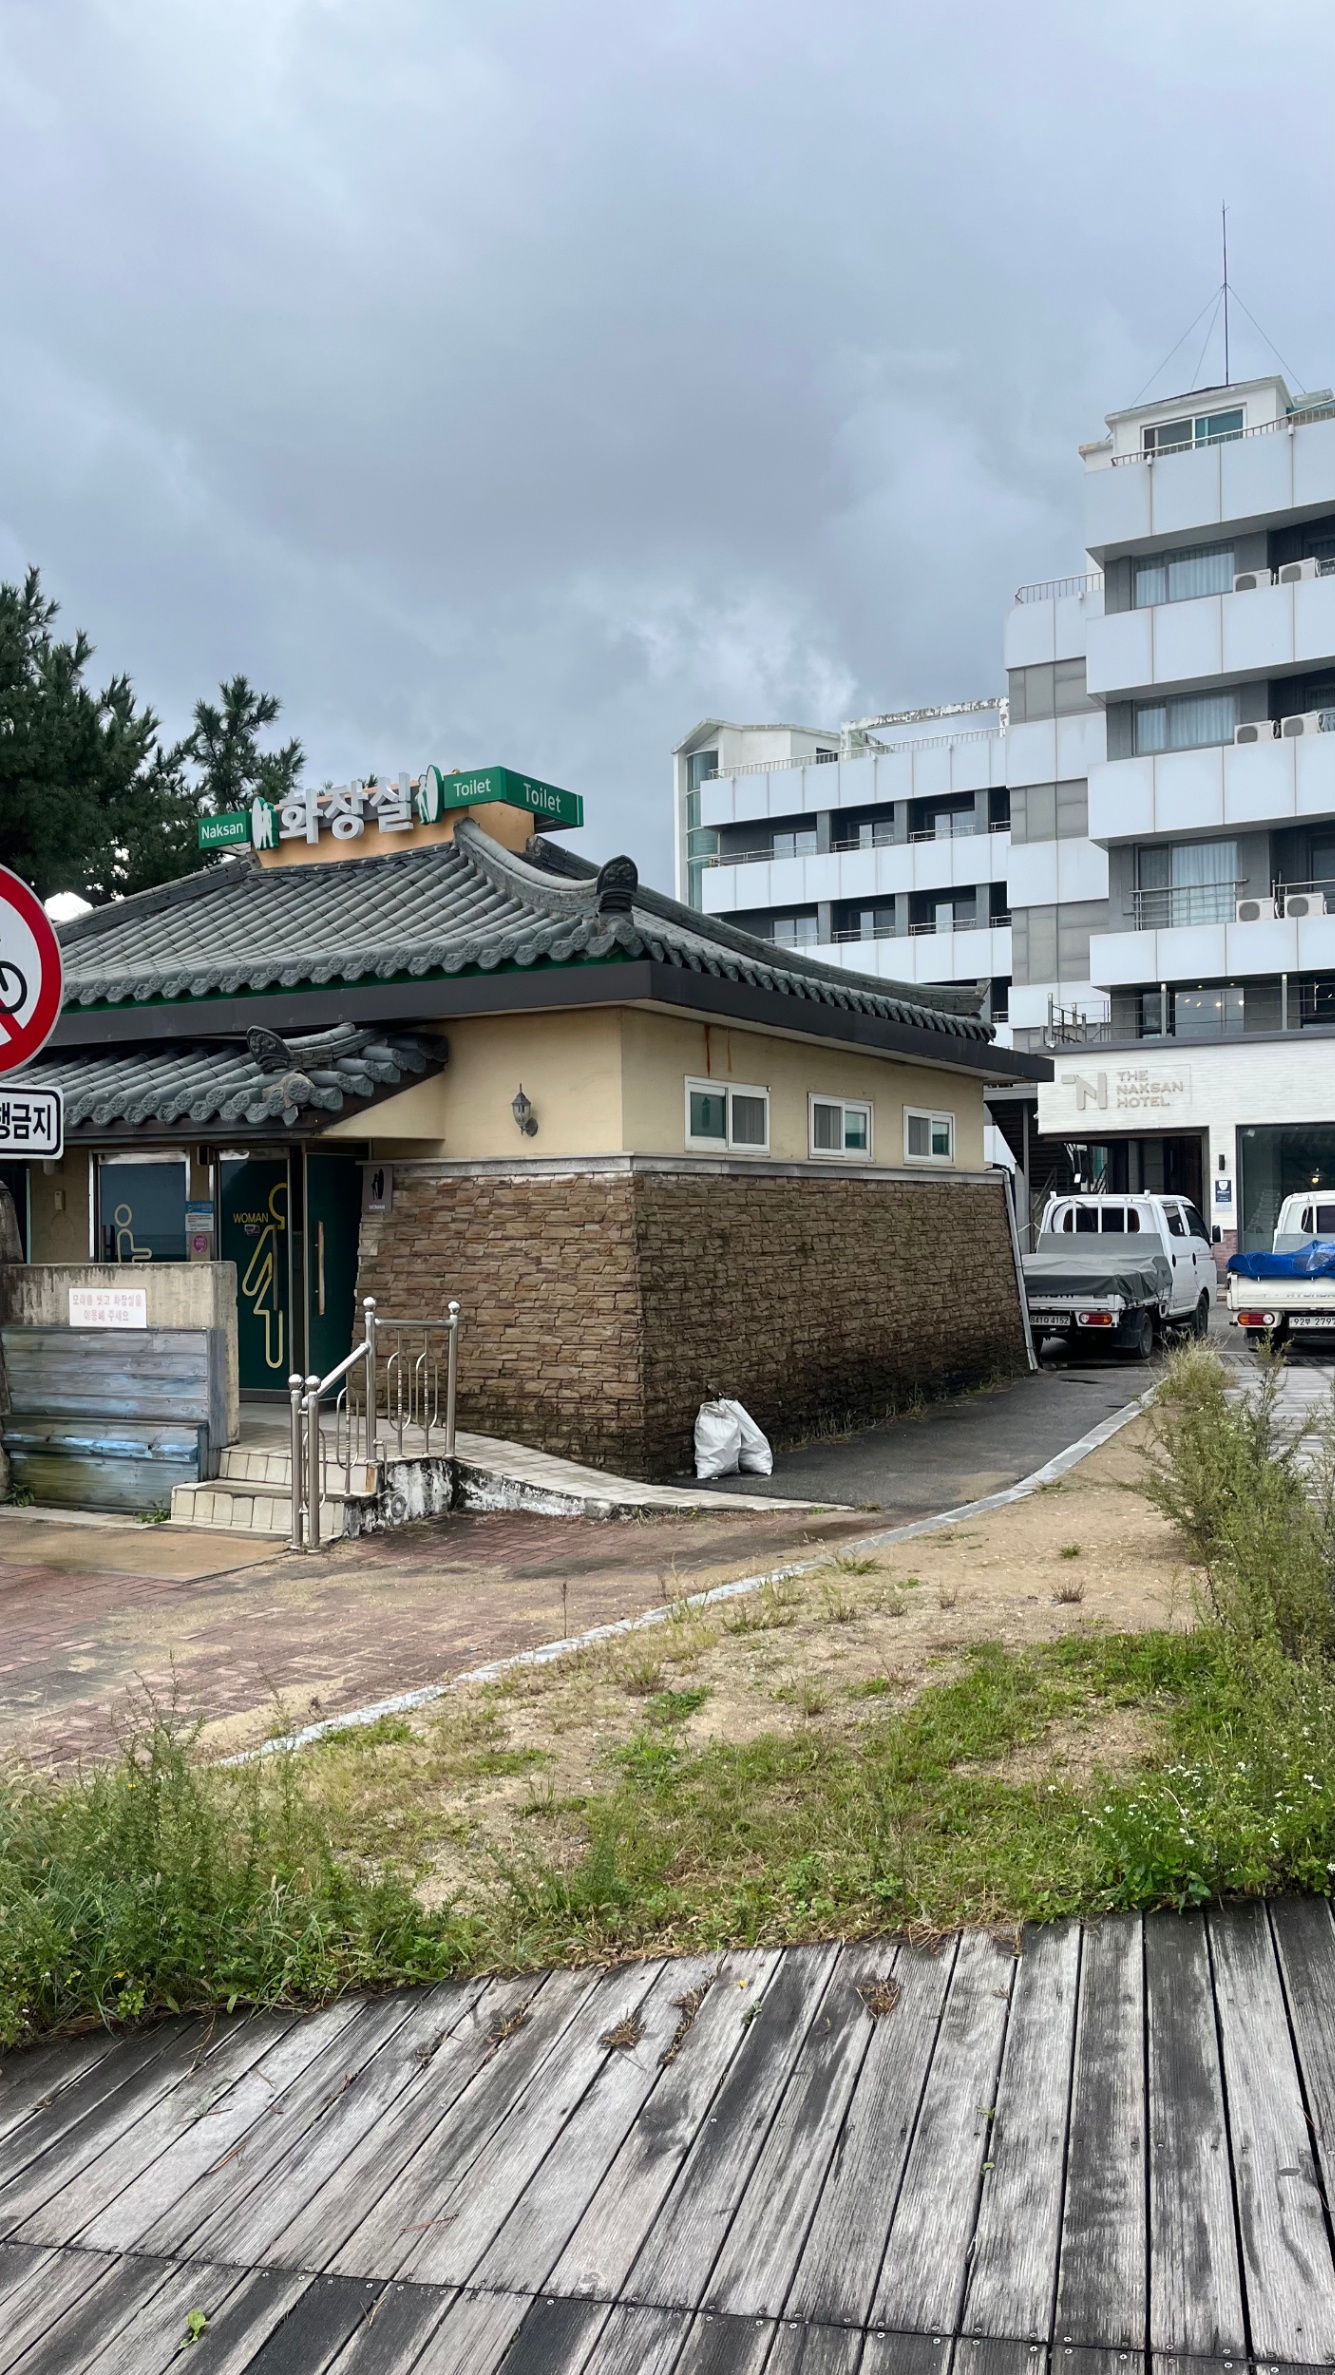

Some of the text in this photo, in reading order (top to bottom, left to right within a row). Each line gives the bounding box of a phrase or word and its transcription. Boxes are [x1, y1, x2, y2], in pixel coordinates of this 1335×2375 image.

[454, 778, 491, 797] Toilet
[523, 782, 562, 813] Toilet
[278, 772, 414, 845] 화장실
[200, 821, 244, 840] Naksan
[1116, 1070, 1148, 1081] THE
[1116, 1081, 1184, 1095] NAKSAN
[1116, 1095, 1171, 1108] HOTEL
[233, 1212, 269, 1223] WOMAN
[113, 1294, 142, 1307] 화장실을
[83, 1309, 129, 1322] 이용해 주세요
